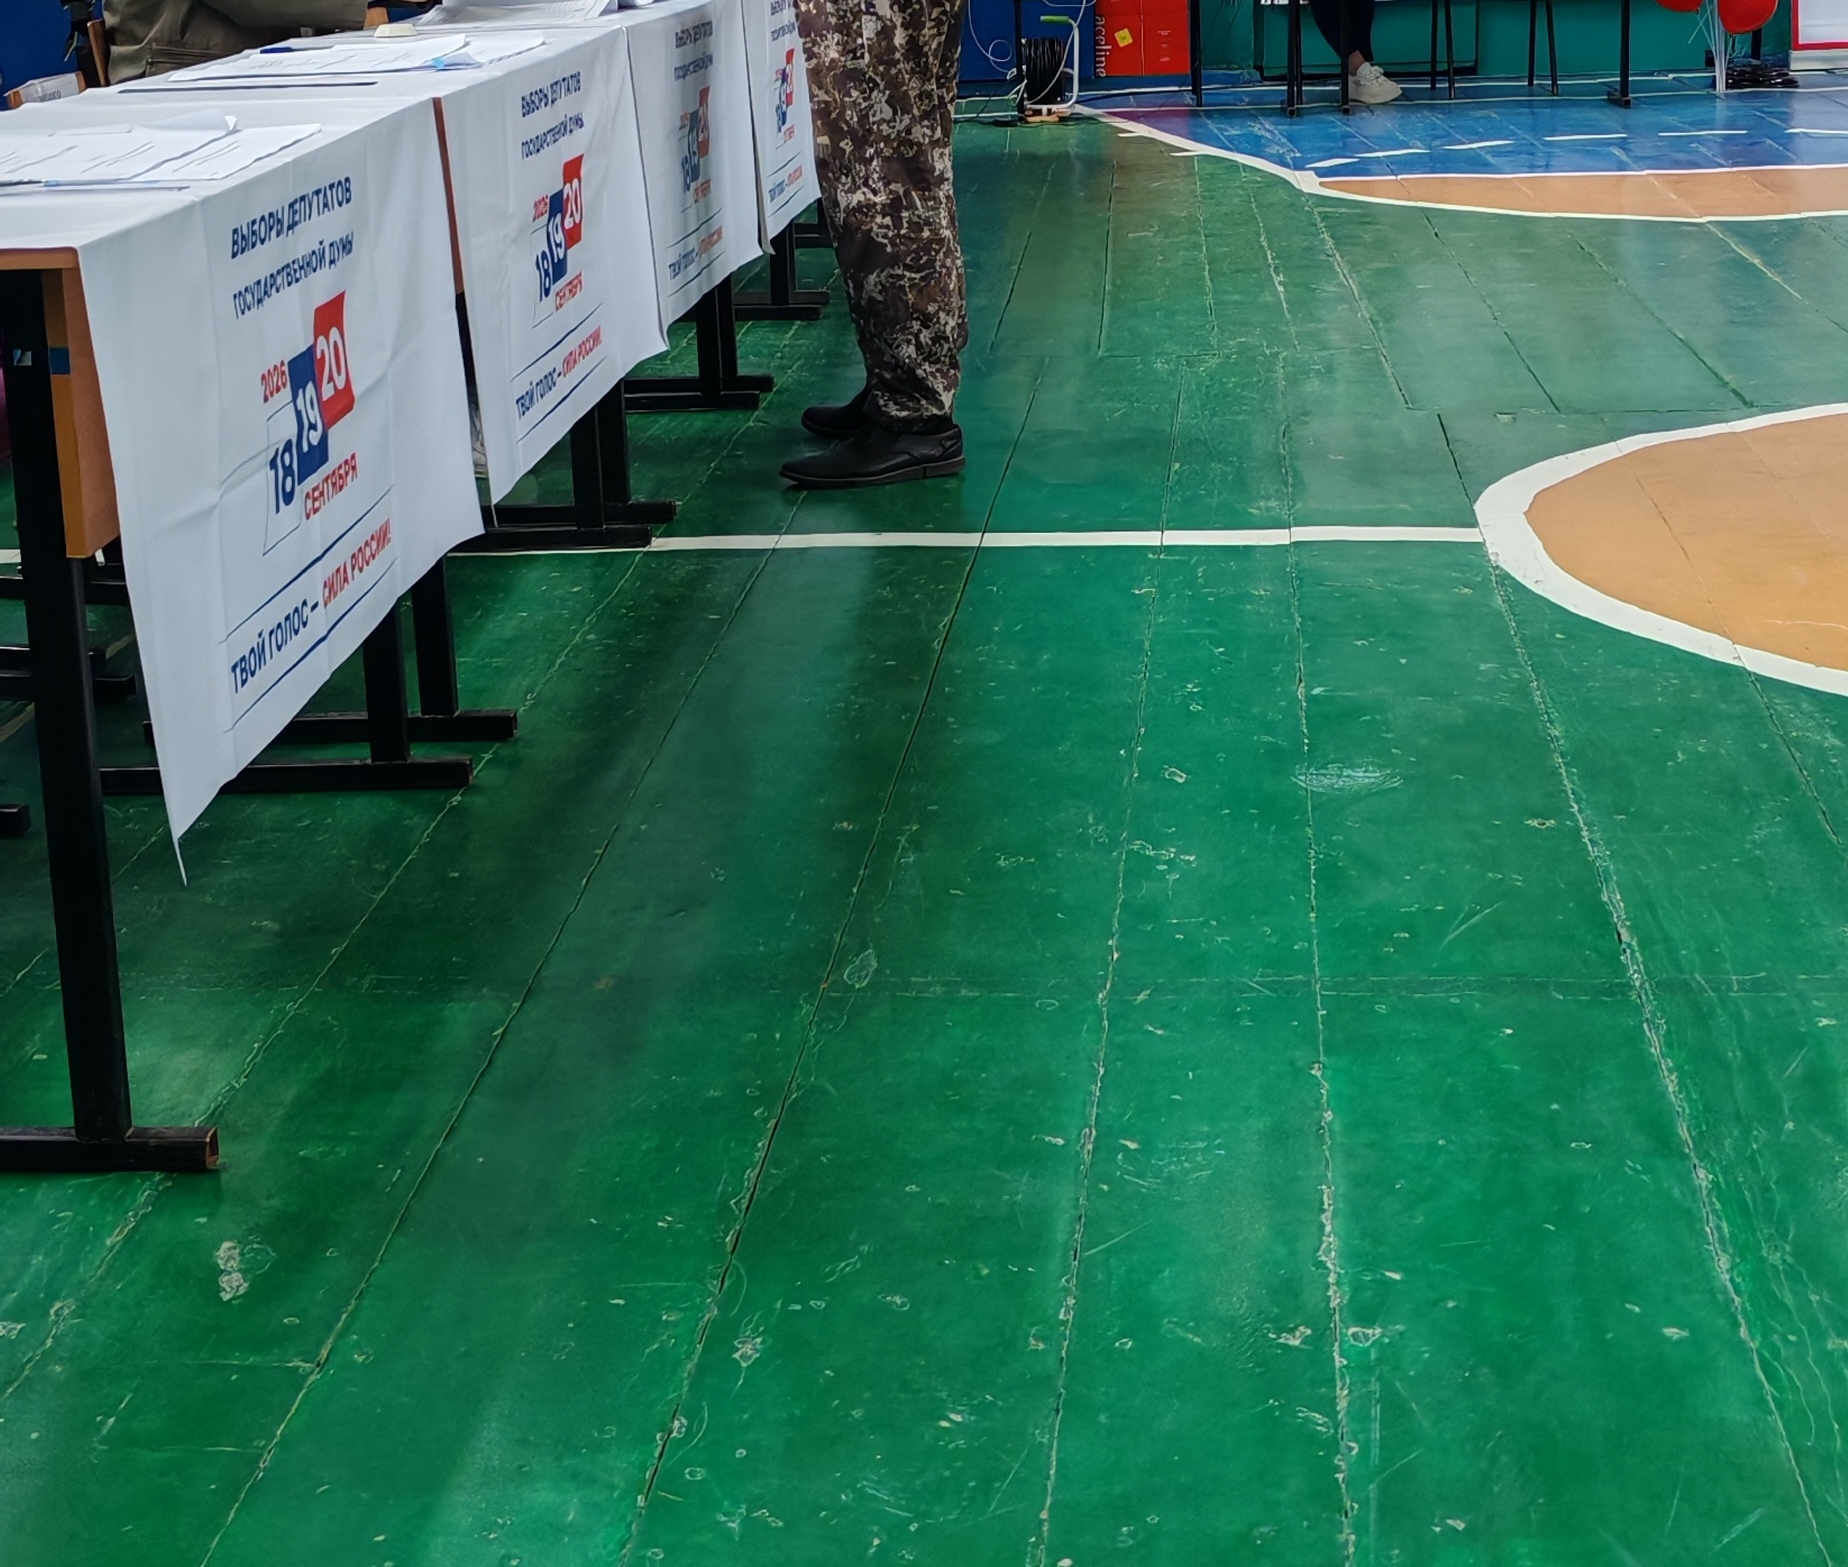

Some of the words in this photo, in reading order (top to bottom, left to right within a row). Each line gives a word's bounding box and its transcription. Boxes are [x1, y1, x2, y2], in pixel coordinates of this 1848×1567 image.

[1095, 16, 1112, 78] aceline
[231, 205, 284, 260] ВЫБОРЫ
[286, 176, 352, 238] ДЕПУТАТОВ
[548, 211, 566, 263] 19
[563, 177, 582, 230] 20
[233, 239, 326, 320] ГОСУДАРСТВЕННОЙ
[328, 230, 355, 270] ДУМЫ
[535, 250, 551, 302] 18
[261, 359, 288, 404] 2026
[316, 326, 347, 403] 20
[296, 379, 324, 454] 19
[268, 437, 296, 515] 18
[304, 451, 358, 521] СЕНТЯБРЯ
[231, 628, 267, 694] ТВОЙ
[268, 598, 309, 660] ГОЛОС
[322, 560, 350, 609] СИЛА
[350, 517, 392, 581] РОССИИ!
